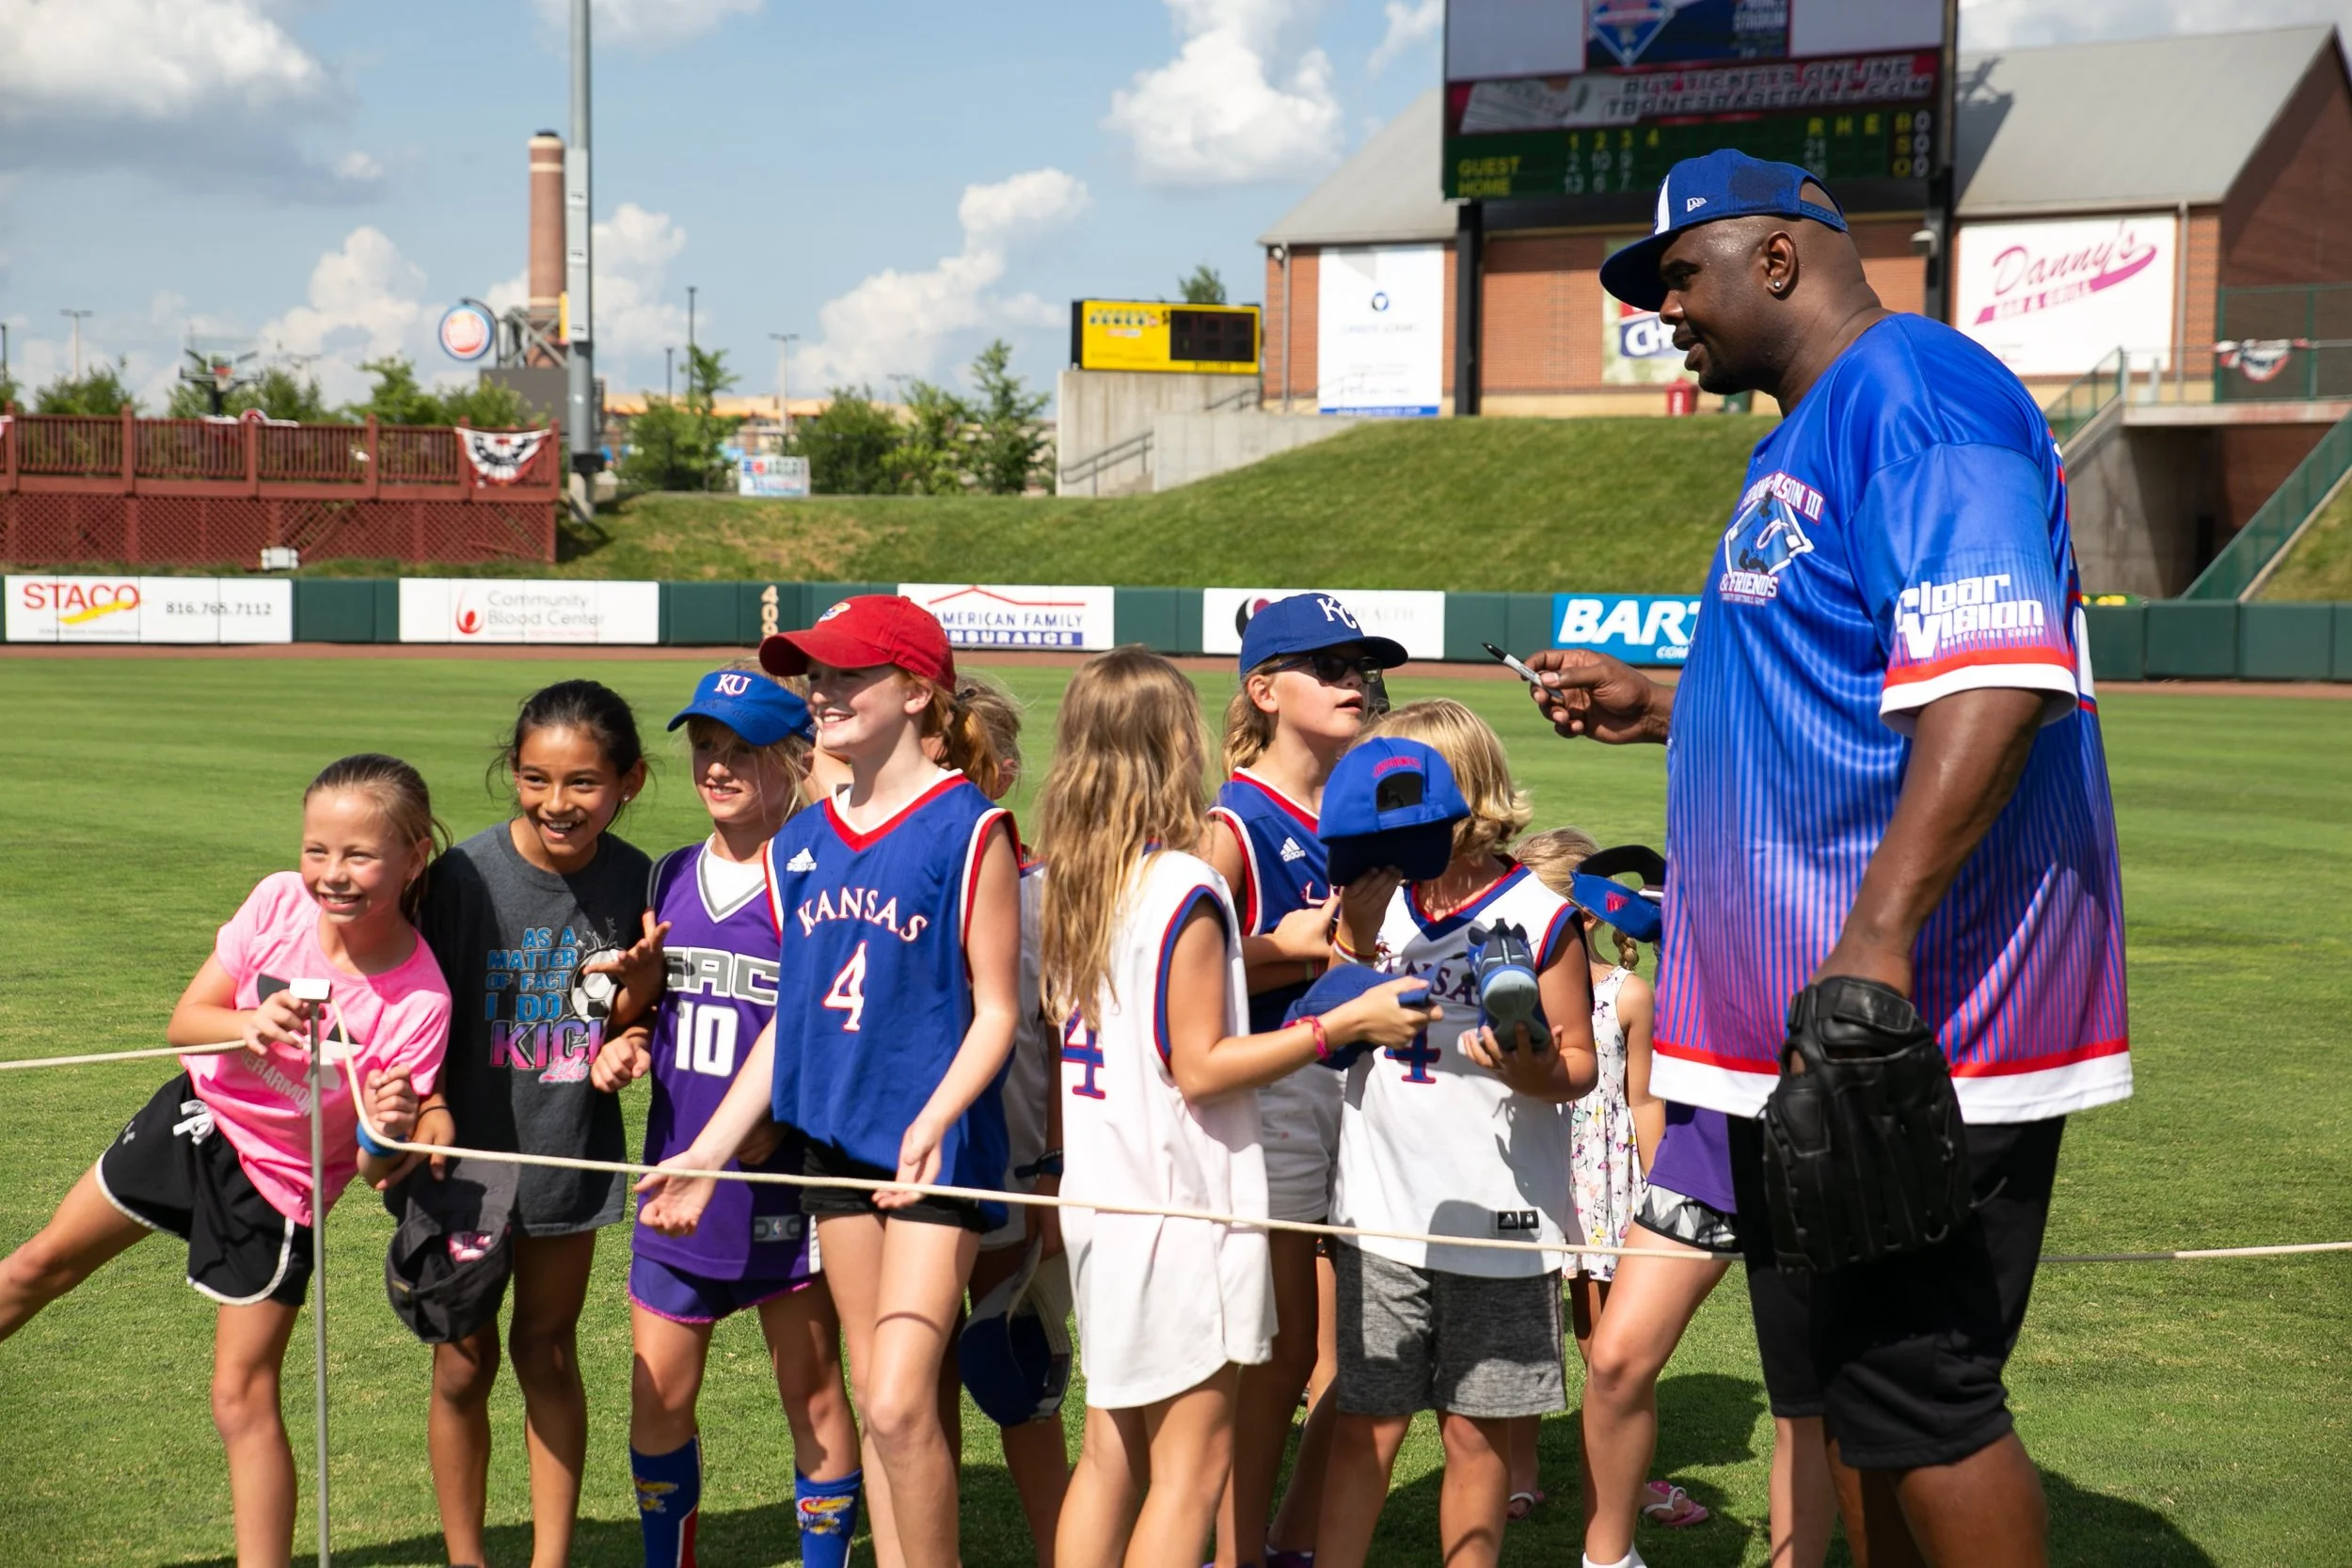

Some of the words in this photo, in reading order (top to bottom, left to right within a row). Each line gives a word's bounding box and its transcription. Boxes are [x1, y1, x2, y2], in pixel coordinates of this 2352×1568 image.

[1802, 55, 1914, 85] ONLINE
[1458, 155, 1521, 177] GUEST
[1458, 178, 1511, 197] HOME
[1993, 219, 2134, 295] Danny's
[23, 582, 141, 610] STACO
[1729, 570, 1779, 597] FRIENDS
[487, 590, 587, 609] Community
[487, 610, 541, 625] Blood
[547, 610, 605, 626] Center
[1025, 613, 1083, 626] FAMILY
[1317, 596, 1357, 629] KC
[946, 630, 1073, 644] NSURANCE
[714, 673, 752, 696] KU
[796, 887, 929, 942] KANSAS
[522, 927, 552, 949] AS
[561, 926, 578, 946] A
[487, 947, 578, 970] MATTER
[485, 973, 513, 990] OF
[520, 971, 572, 991] FACT
[822, 940, 867, 1032] 4
[485, 992, 498, 1021] I
[516, 991, 564, 1022] DO
[675, 999, 739, 1077] 10
[1061, 1003, 1105, 1100] 4
